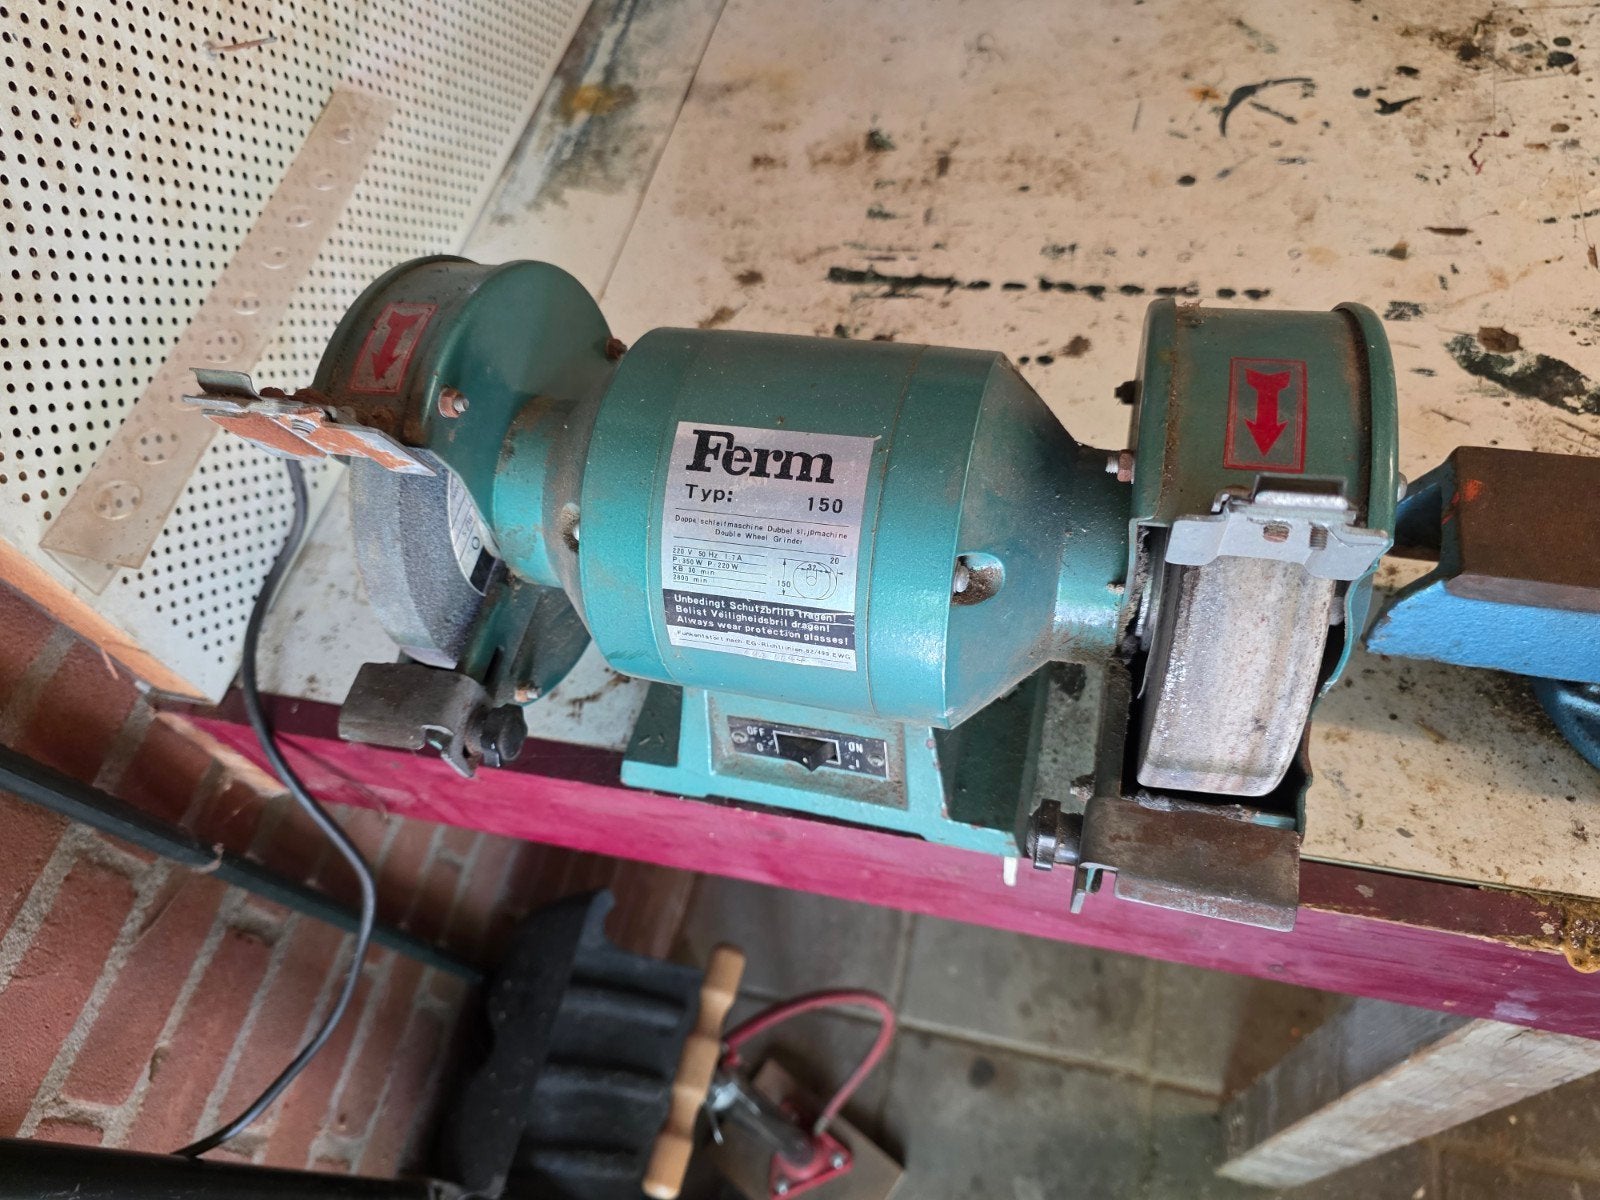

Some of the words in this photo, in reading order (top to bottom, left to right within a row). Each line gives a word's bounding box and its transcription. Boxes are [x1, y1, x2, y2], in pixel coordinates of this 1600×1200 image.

[685, 429, 835, 484] Ferm
[685, 483, 733, 503] Typ:
[808, 497, 843, 514] 150
[715, 528, 742, 538] Double
[745, 532, 768, 541] Wheel
[773, 535, 803, 545] Grinder
[767, 525, 793, 536] Dubbel
[830, 557, 840, 565] 20
[777, 580, 791, 588] 150
[674, 594, 726, 609] Unbedingt
[729, 601, 795, 617] Schutzbrille
[710, 609, 787, 626] Veiligheidsbril
[791, 620, 830, 632] dragen!
[677, 615, 715, 627] Always
[717, 622, 741, 630] wear
[745, 625, 801, 639] protection
[804, 632, 848, 645] glasses!
[832, 652, 850, 660] EWG
[746, 726, 765, 737] OFF
[848, 742, 864, 754] ON
